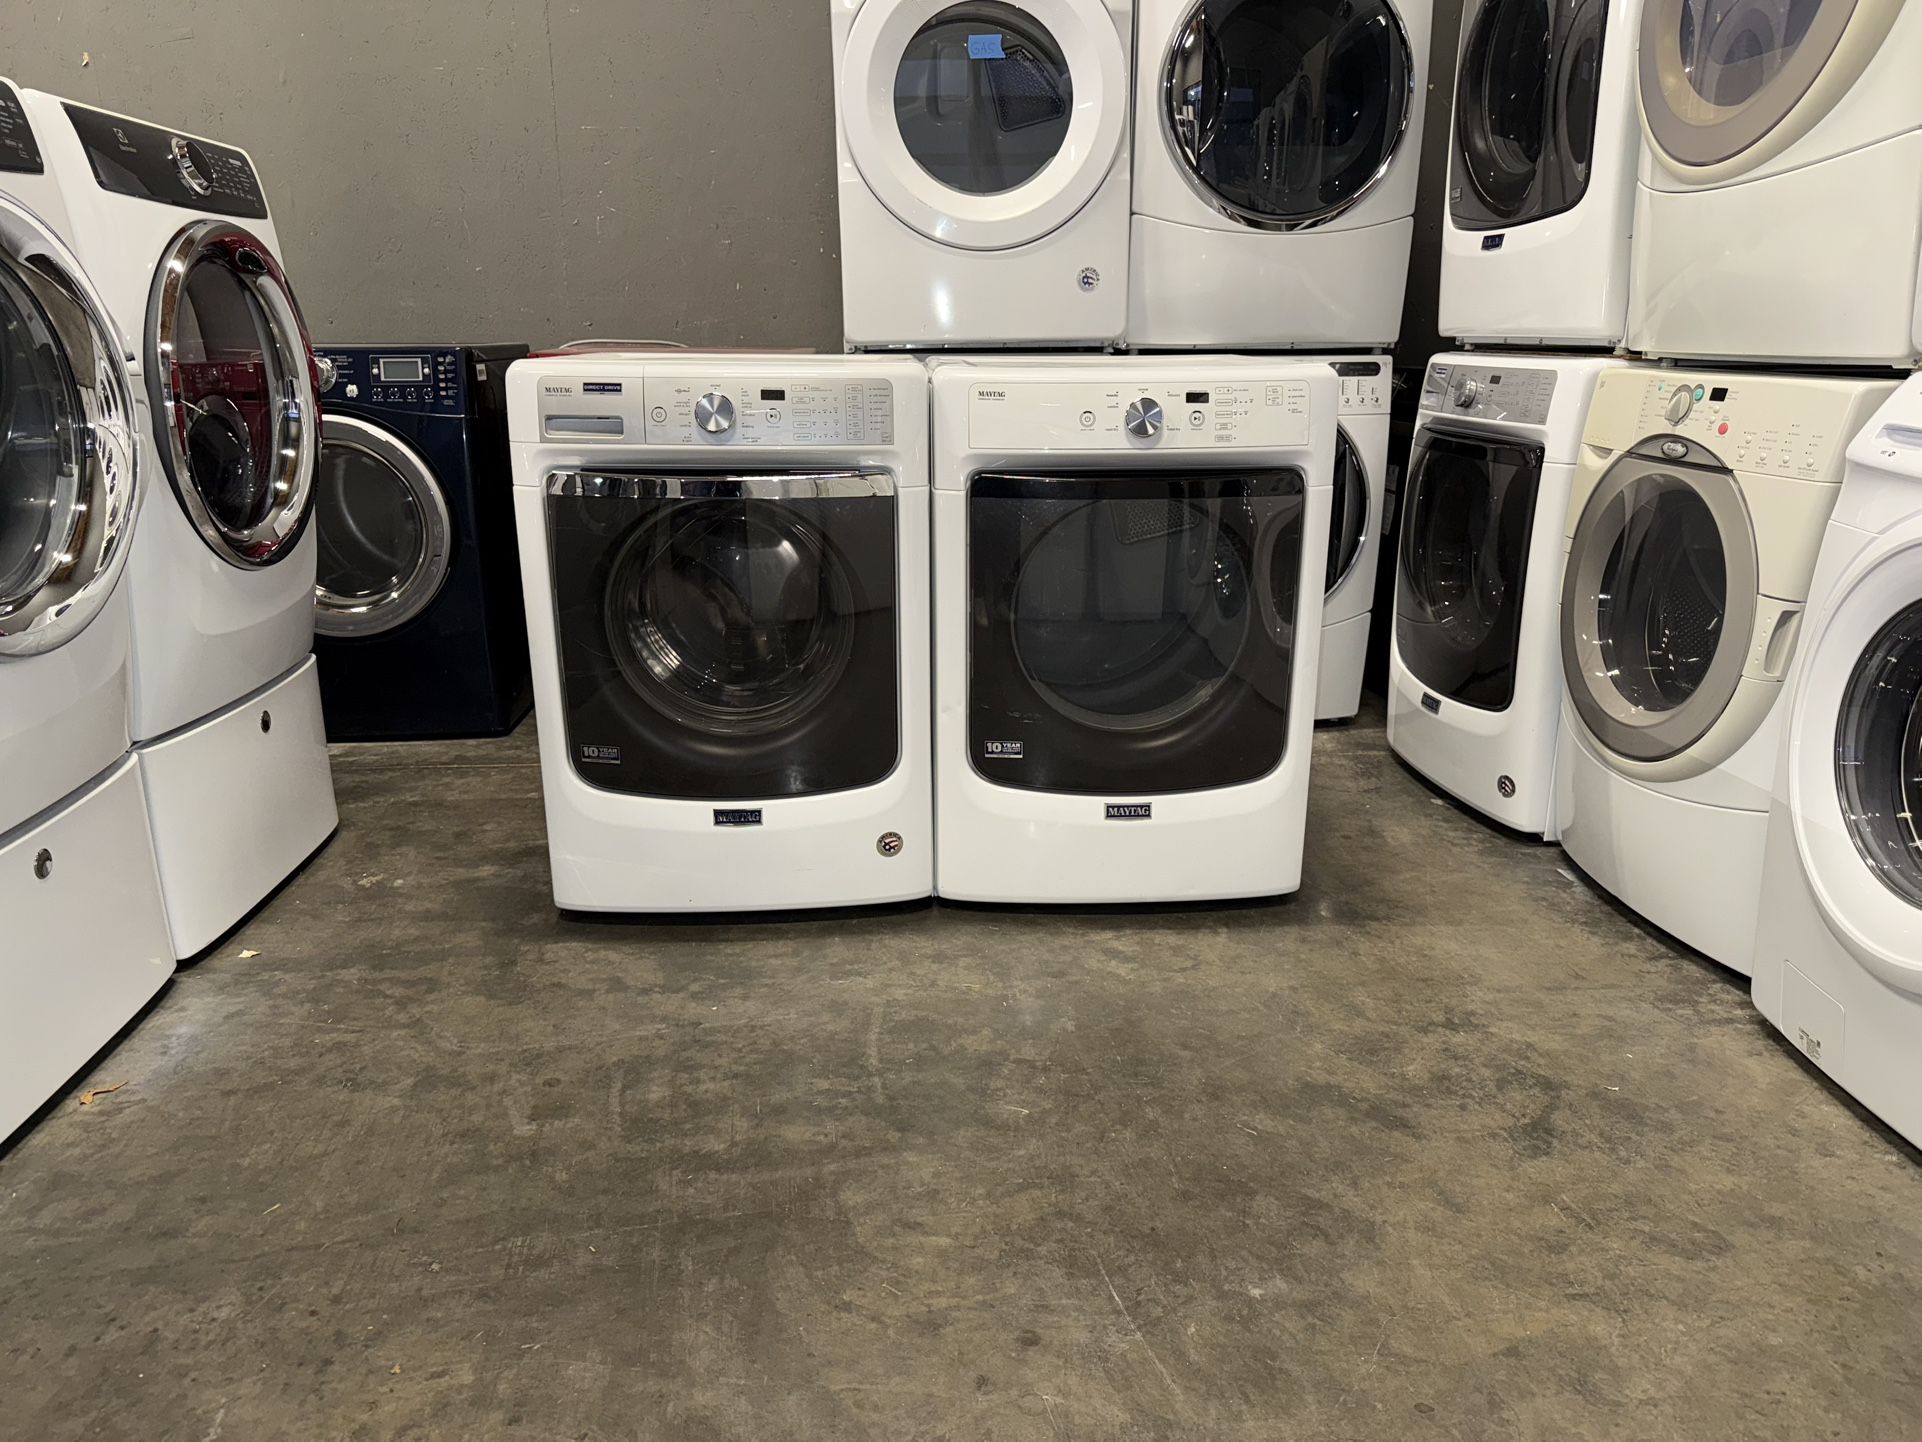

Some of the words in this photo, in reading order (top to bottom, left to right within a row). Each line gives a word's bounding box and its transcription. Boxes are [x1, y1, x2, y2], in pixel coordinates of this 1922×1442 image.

[971, 41, 996, 54] GAS
[582, 746, 599, 757] 10
[986, 742, 1002, 752] 10
[717, 812, 760, 822] MAYTAG
[1107, 806, 1150, 817] MAYTAG
